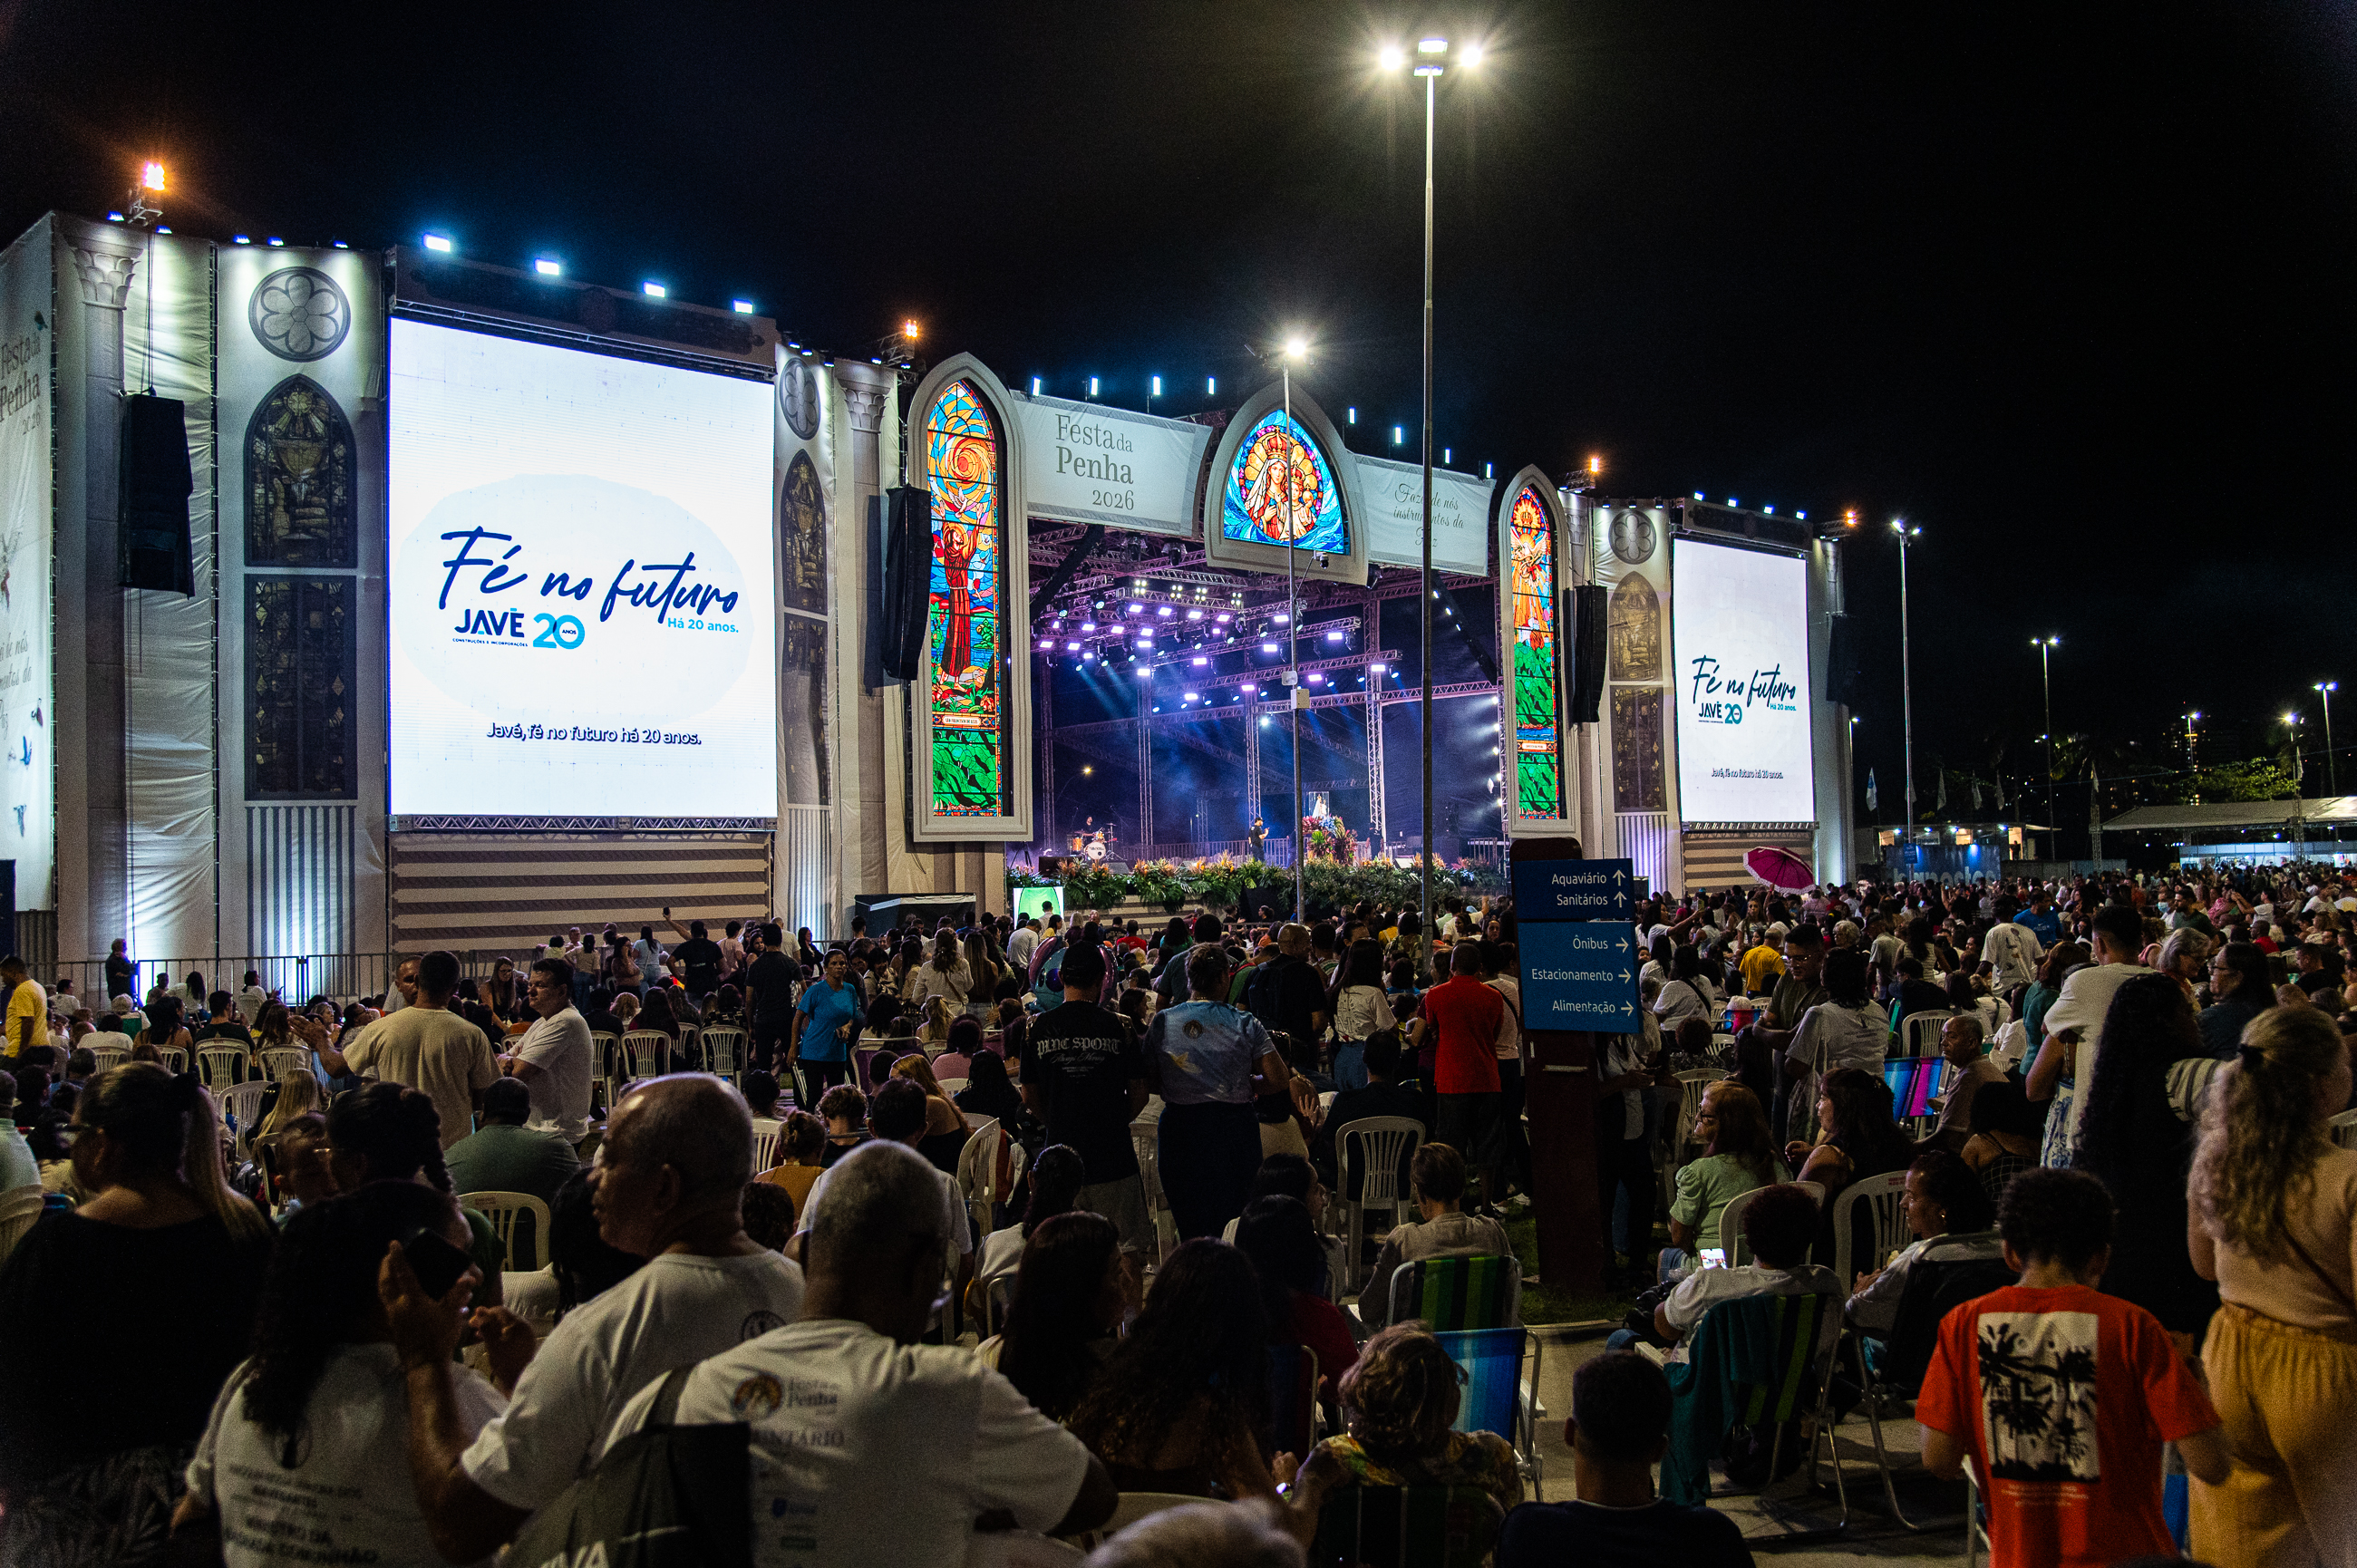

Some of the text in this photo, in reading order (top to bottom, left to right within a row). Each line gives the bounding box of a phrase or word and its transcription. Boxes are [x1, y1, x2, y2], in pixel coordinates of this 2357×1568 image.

[0, 371, 41, 422] Penha
[1055, 413, 1133, 453] Festa da
[1055, 445, 1134, 485] Penha
[1092, 489, 1134, 510] 2026
[1443, 497, 1459, 510] nós
[1452, 513, 1464, 528] da
[439, 526, 739, 624] Fé no futuro
[533, 613, 586, 650] 20
[667, 617, 739, 633] Há 20 anos.
[1692, 654, 1797, 708] Fé no futuro
[1724, 702, 1742, 724] 20
[487, 722, 702, 745] Javé, fé no futuro há 20 anos.
[1551, 872, 1607, 886] Aquaviário
[1557, 894, 1608, 906] Sanitários
[1573, 934, 1609, 950] Ônibus
[1531, 968, 1614, 982] Estacionamento
[1552, 1000, 1615, 1014] Alimentação
[1072, 1037, 1121, 1055] SPORT
